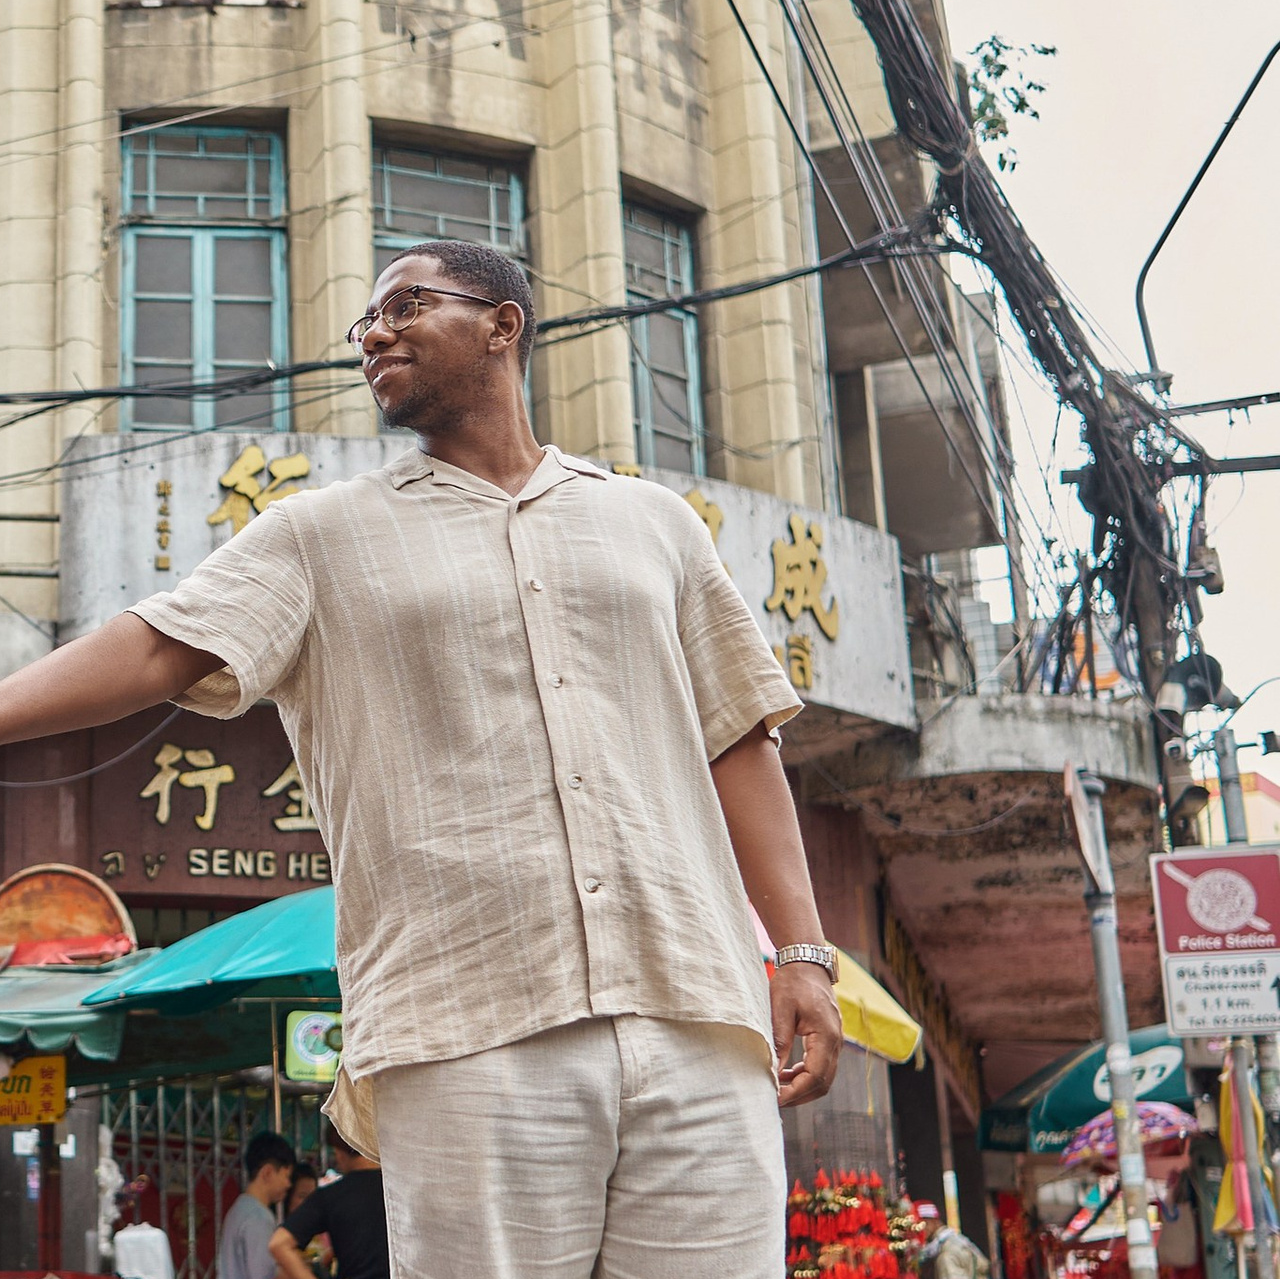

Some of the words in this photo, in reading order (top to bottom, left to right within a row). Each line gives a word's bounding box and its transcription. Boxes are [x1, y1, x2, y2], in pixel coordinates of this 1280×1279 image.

[188, 848, 277, 878] SENG
[1178, 934, 1222, 951] Police
[1225, 932, 1276, 949] Station
